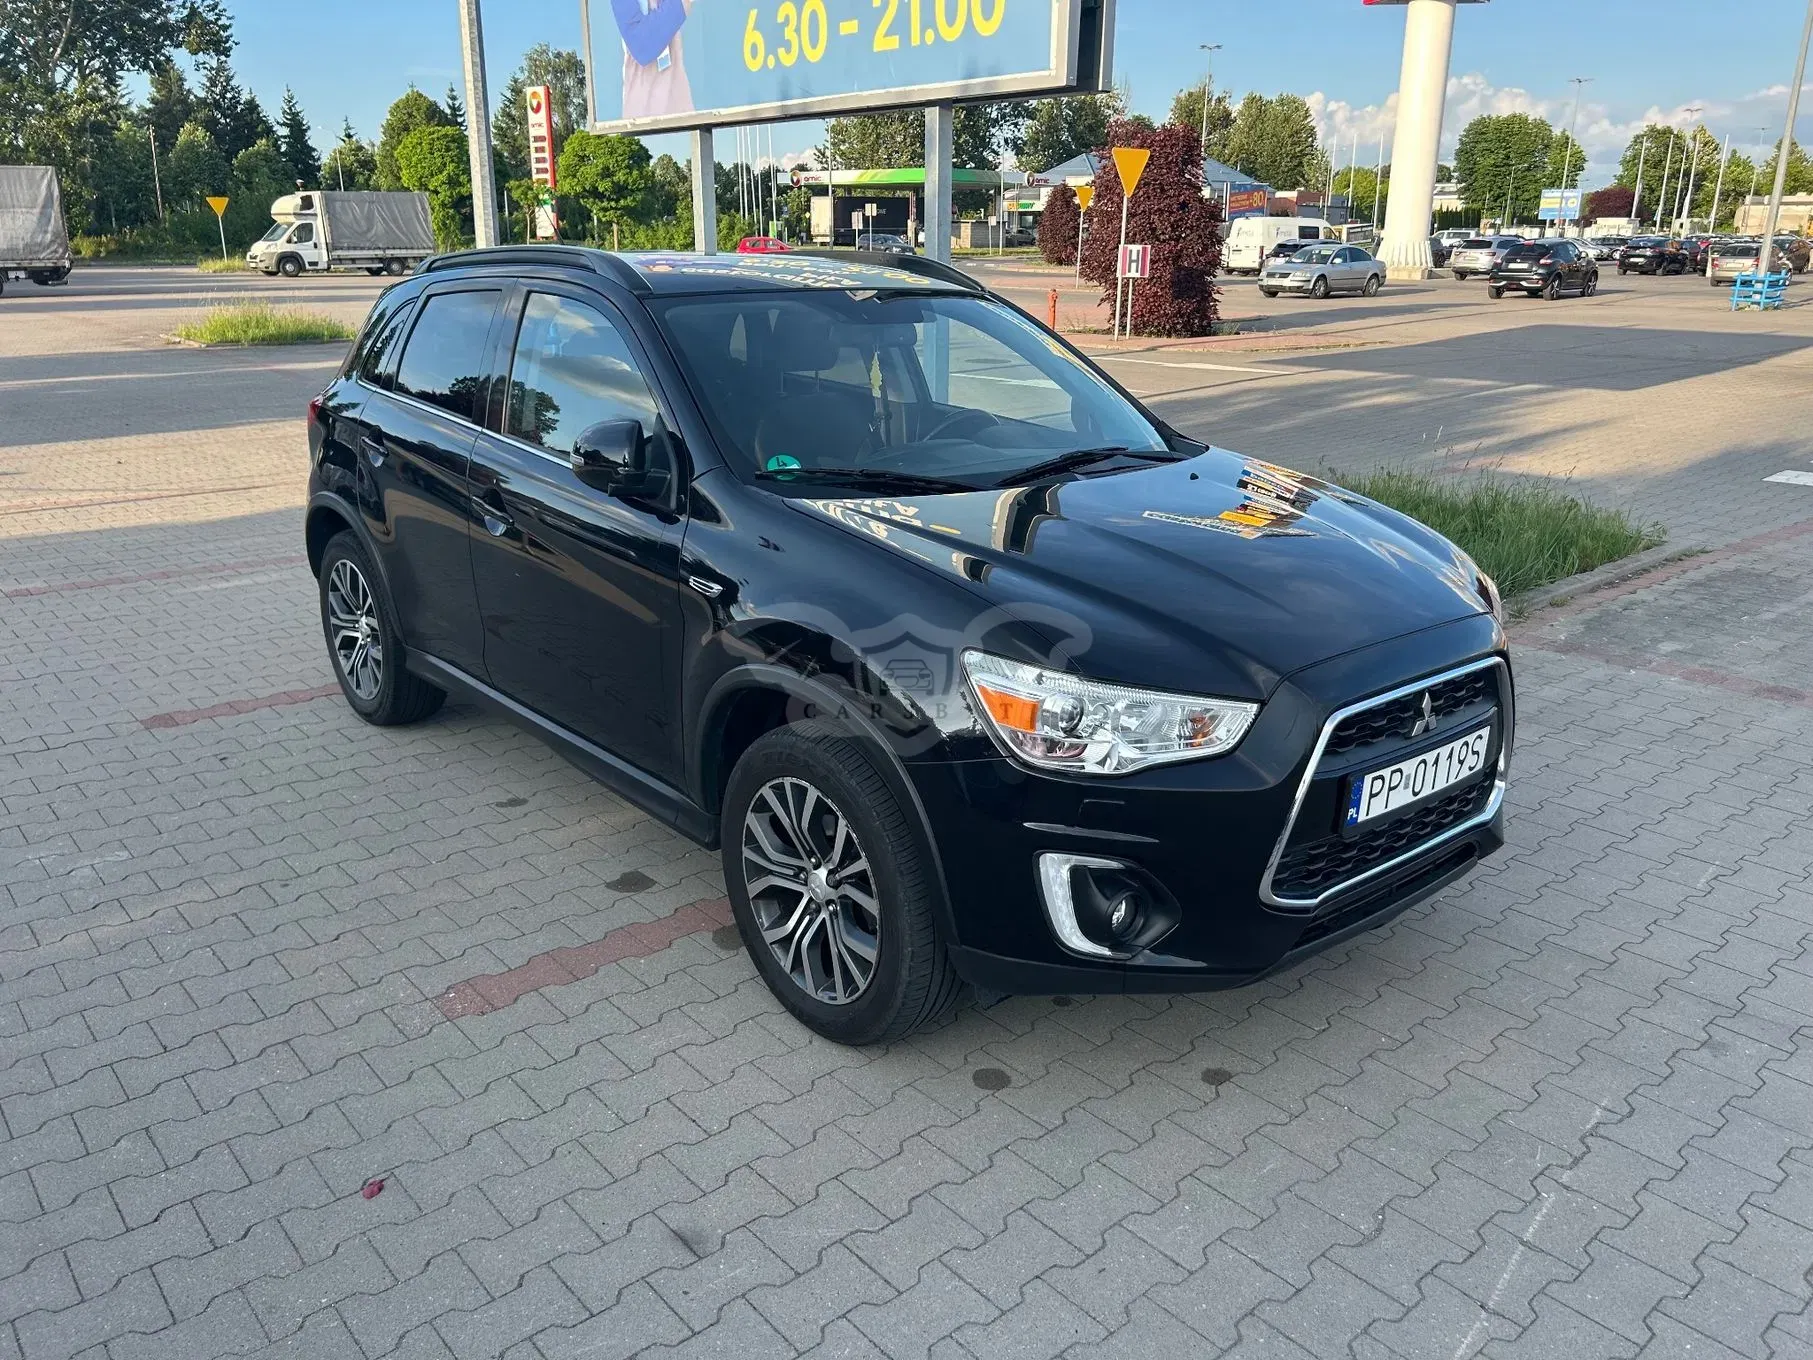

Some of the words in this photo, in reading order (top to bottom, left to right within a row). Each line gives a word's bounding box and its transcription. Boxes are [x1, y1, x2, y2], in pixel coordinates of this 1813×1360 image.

[743, 1, 828, 72] 6.30
[873, 0, 1004, 53] 21.00
[1007, 202, 1035, 210] SUWAY
[1127, 250, 1140, 273] H
[1365, 767, 1403, 817] PP
[1411, 733, 1483, 798] 0119S
[1347, 807, 1358, 820] PL
